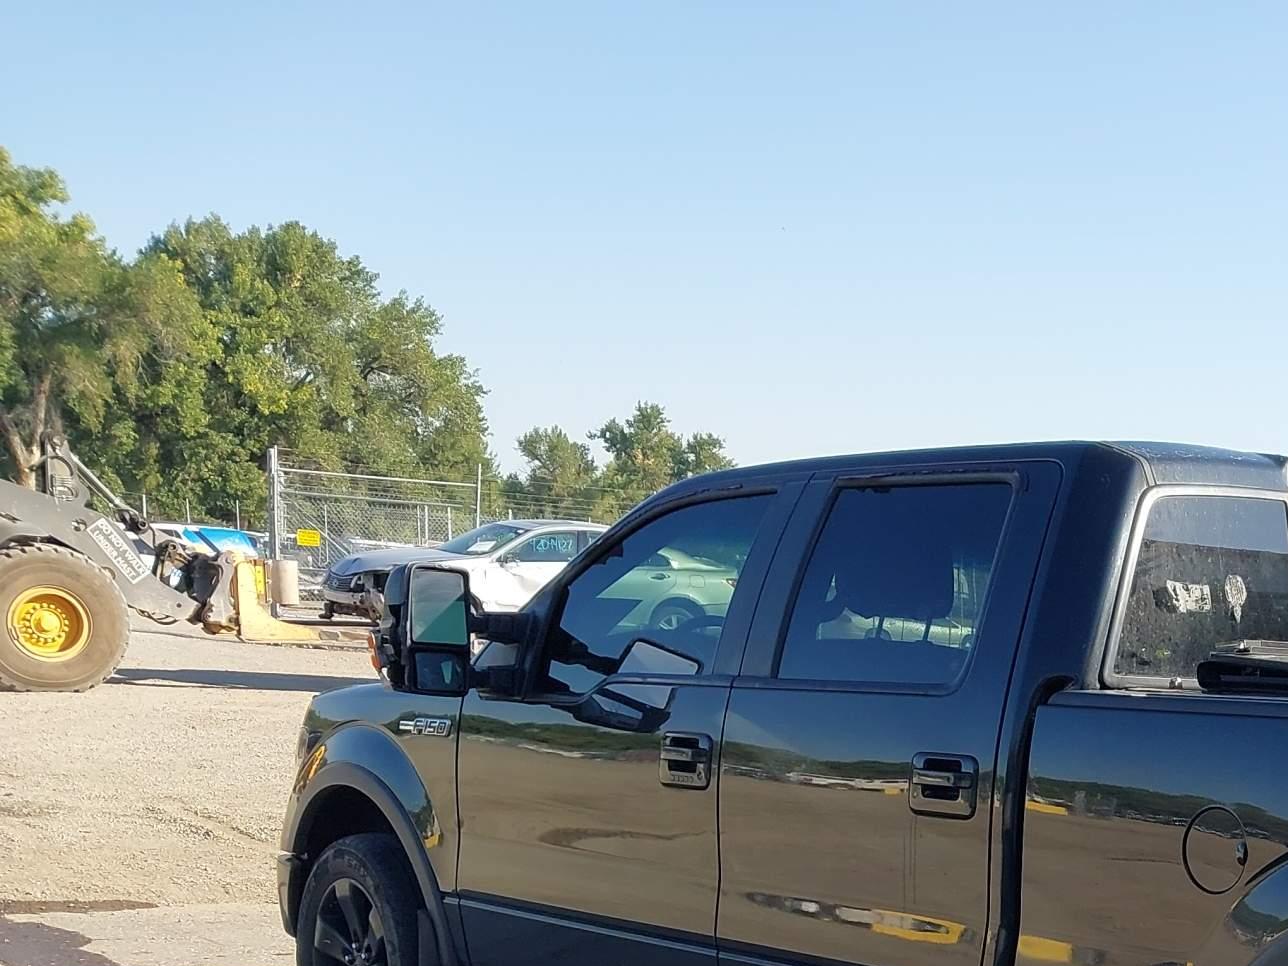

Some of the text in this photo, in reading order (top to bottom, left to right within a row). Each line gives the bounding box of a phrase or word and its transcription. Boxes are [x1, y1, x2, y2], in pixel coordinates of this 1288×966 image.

[93, 530, 137, 578] UNDER MAST
[97, 520, 147, 575] DO NOT WALK
